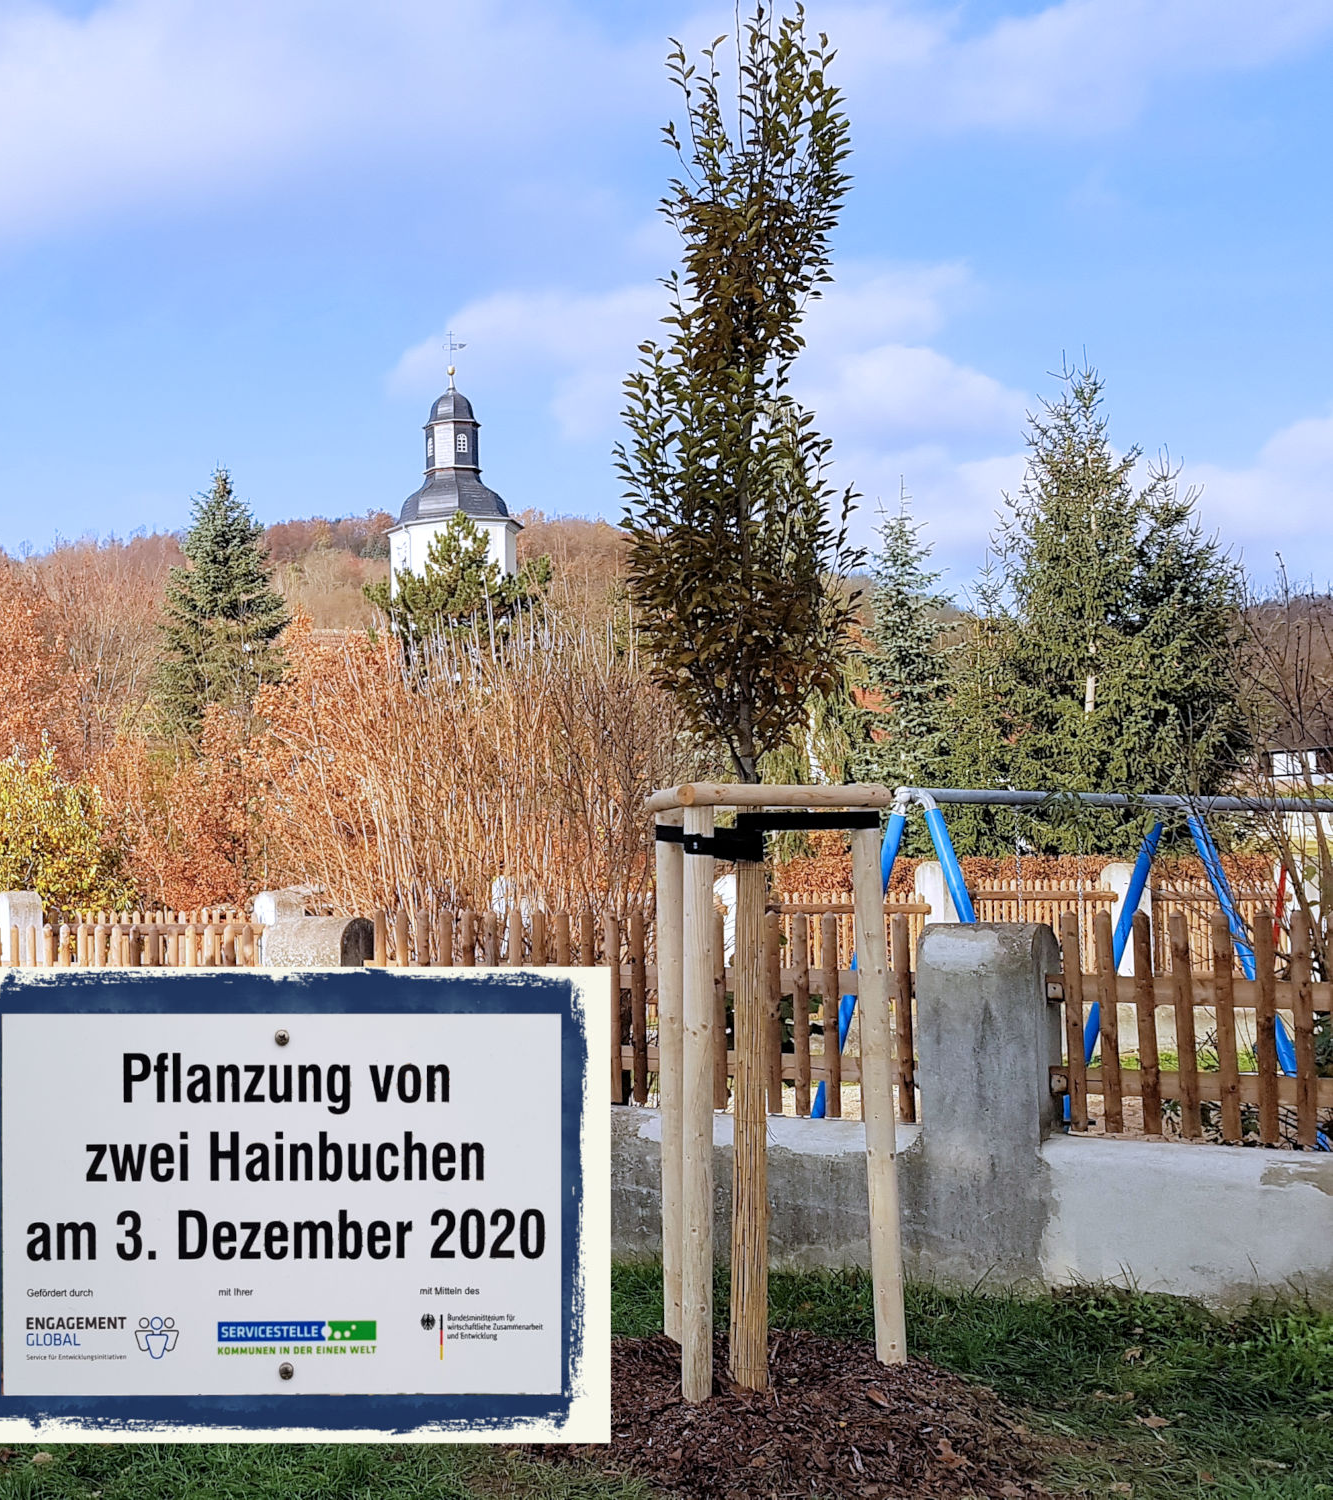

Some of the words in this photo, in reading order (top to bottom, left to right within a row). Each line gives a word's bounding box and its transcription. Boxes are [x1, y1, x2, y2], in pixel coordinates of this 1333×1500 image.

[123, 1053, 351, 1115] Pflanzung
[369, 1063, 450, 1103] von
[86, 1131, 188, 1182] zwei
[210, 1131, 484, 1182] Hainbuchen
[27, 1222, 96, 1261] am
[116, 1210, 156, 1261] 3.
[178, 1210, 412, 1260] Dezember
[431, 1208, 545, 1259] 2020
[27, 1289, 67, 1297] Gefördert
[69, 1289, 93, 1297] durch
[219, 1288, 231, 1296] mit
[234, 1288, 253, 1296] Ihrer
[420, 1287, 432, 1295] mit
[434, 1287, 462, 1295] Mitteln
[465, 1287, 480, 1295] des
[26, 1317, 127, 1330] ENGAGEMENT
[220, 1325, 319, 1338] SERVICESTELLE
[460, 1332, 497, 1341] Entwicklung
[27, 1333, 81, 1346] GLOBAL
[218, 1346, 276, 1355] KOMMUNEN
[294, 1346, 312, 1354] DER
[316, 1346, 346, 1354] EINEN
[350, 1346, 376, 1354] WELT
